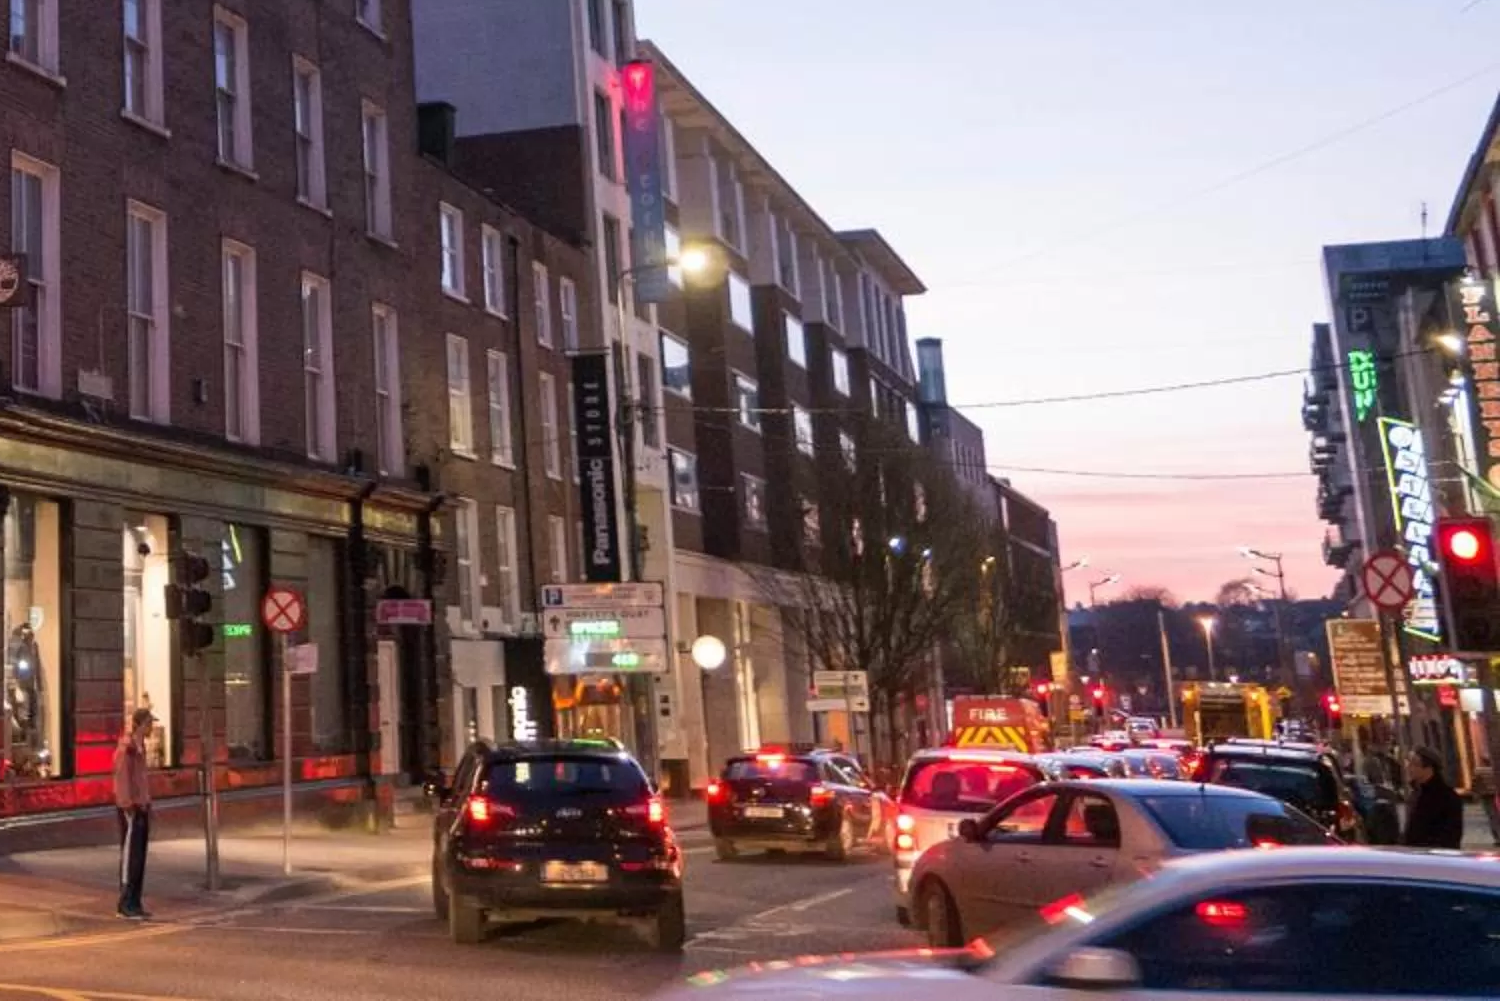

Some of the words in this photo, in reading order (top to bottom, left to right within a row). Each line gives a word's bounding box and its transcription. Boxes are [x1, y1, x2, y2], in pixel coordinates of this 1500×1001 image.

[584, 382, 604, 447] STORE
[589, 458, 612, 566] Panasonic
[968, 707, 1007, 722] FIRE
